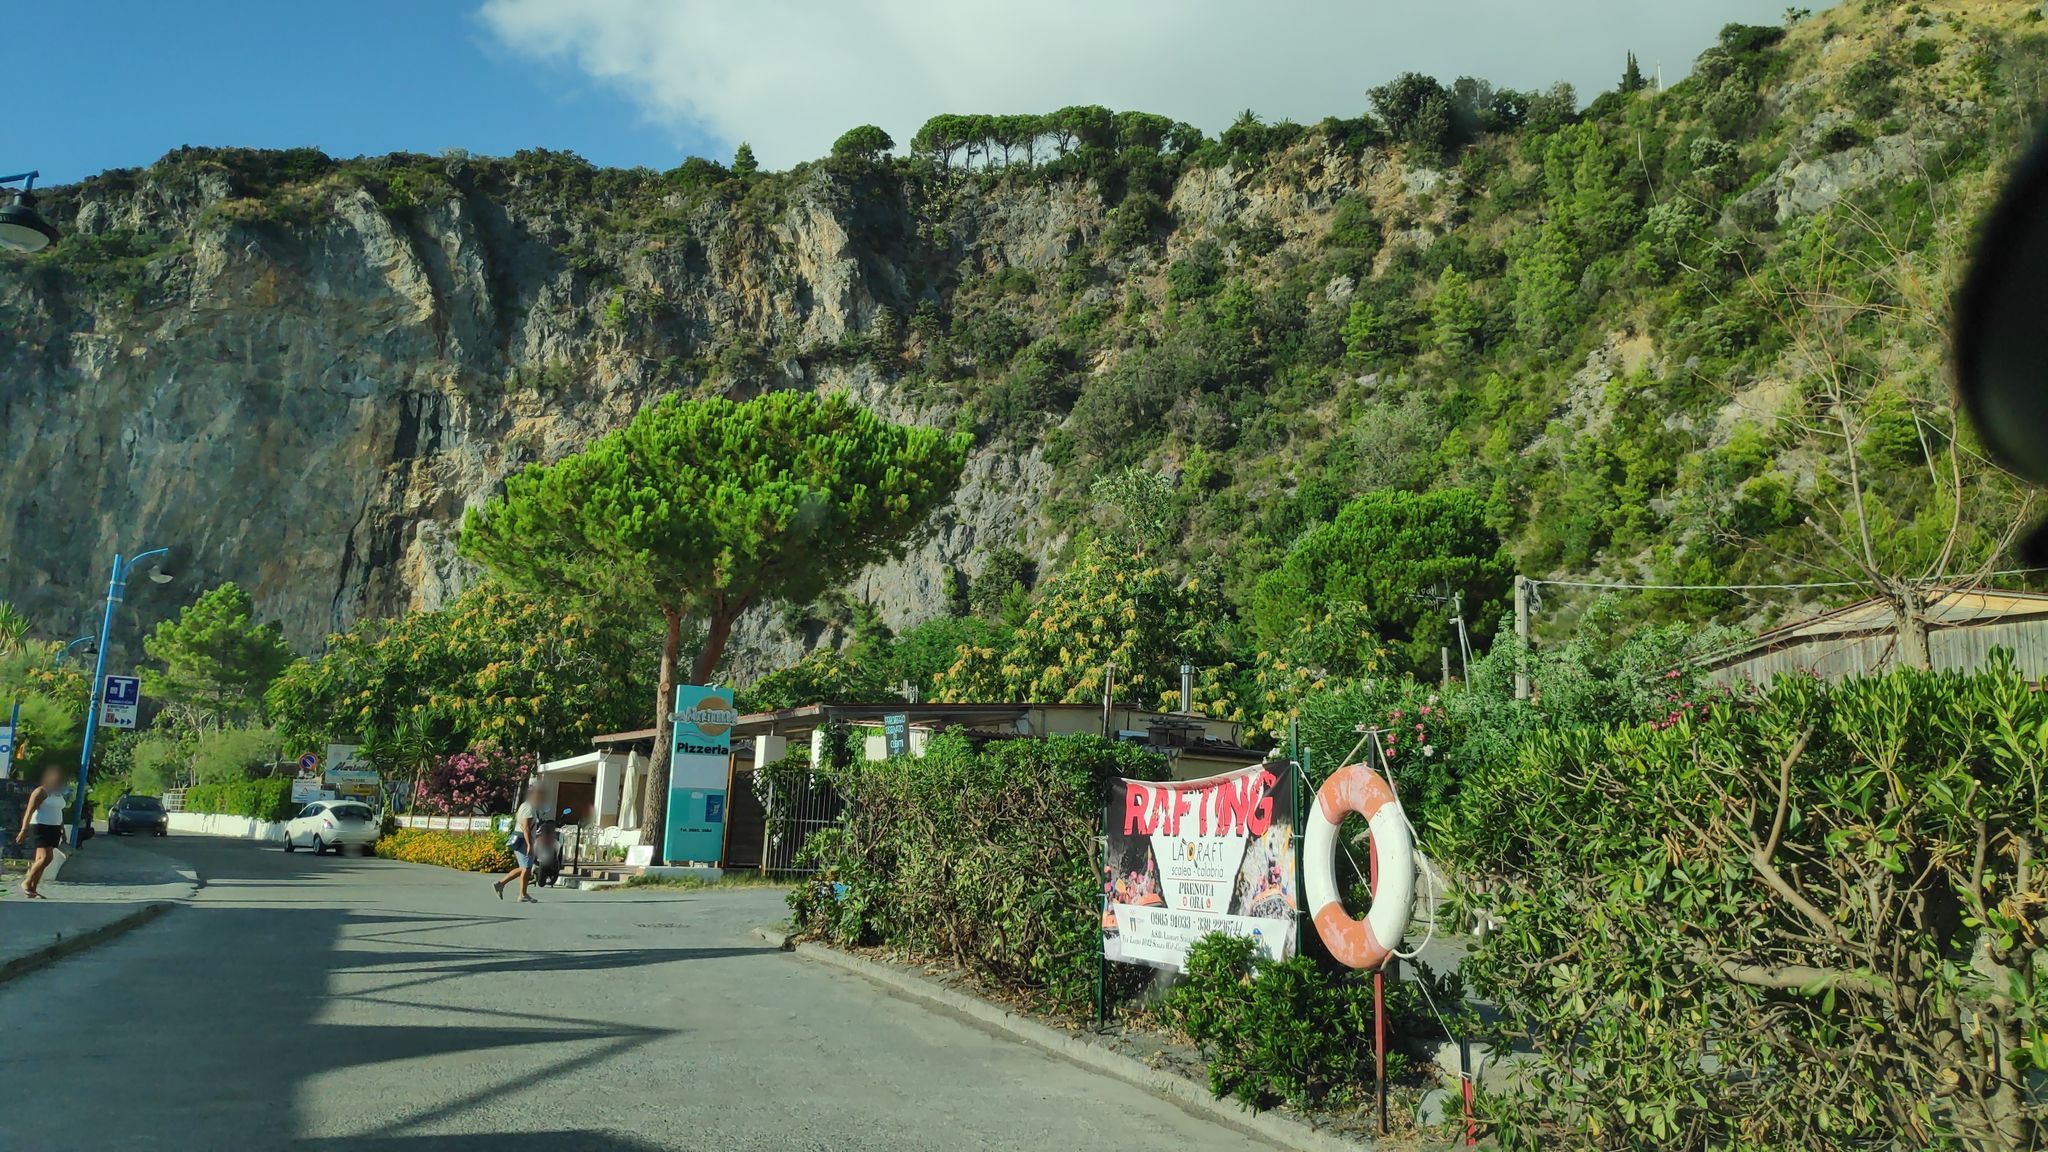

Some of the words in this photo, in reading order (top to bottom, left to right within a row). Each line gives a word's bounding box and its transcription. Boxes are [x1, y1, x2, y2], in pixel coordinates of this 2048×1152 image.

[114, 680, 133, 698] T
[677, 742, 729, 755] Pizzeria
[1123, 770, 1277, 838] RAFTING
[1171, 863, 1192, 877] scalea
[1197, 863, 1224, 878] calabria
[1178, 881, 1214, 897] PRENOTA
[1189, 896, 1204, 909] ORA
[1150, 912, 1168, 926] 0985
[1170, 914, 1191, 929] 91033
